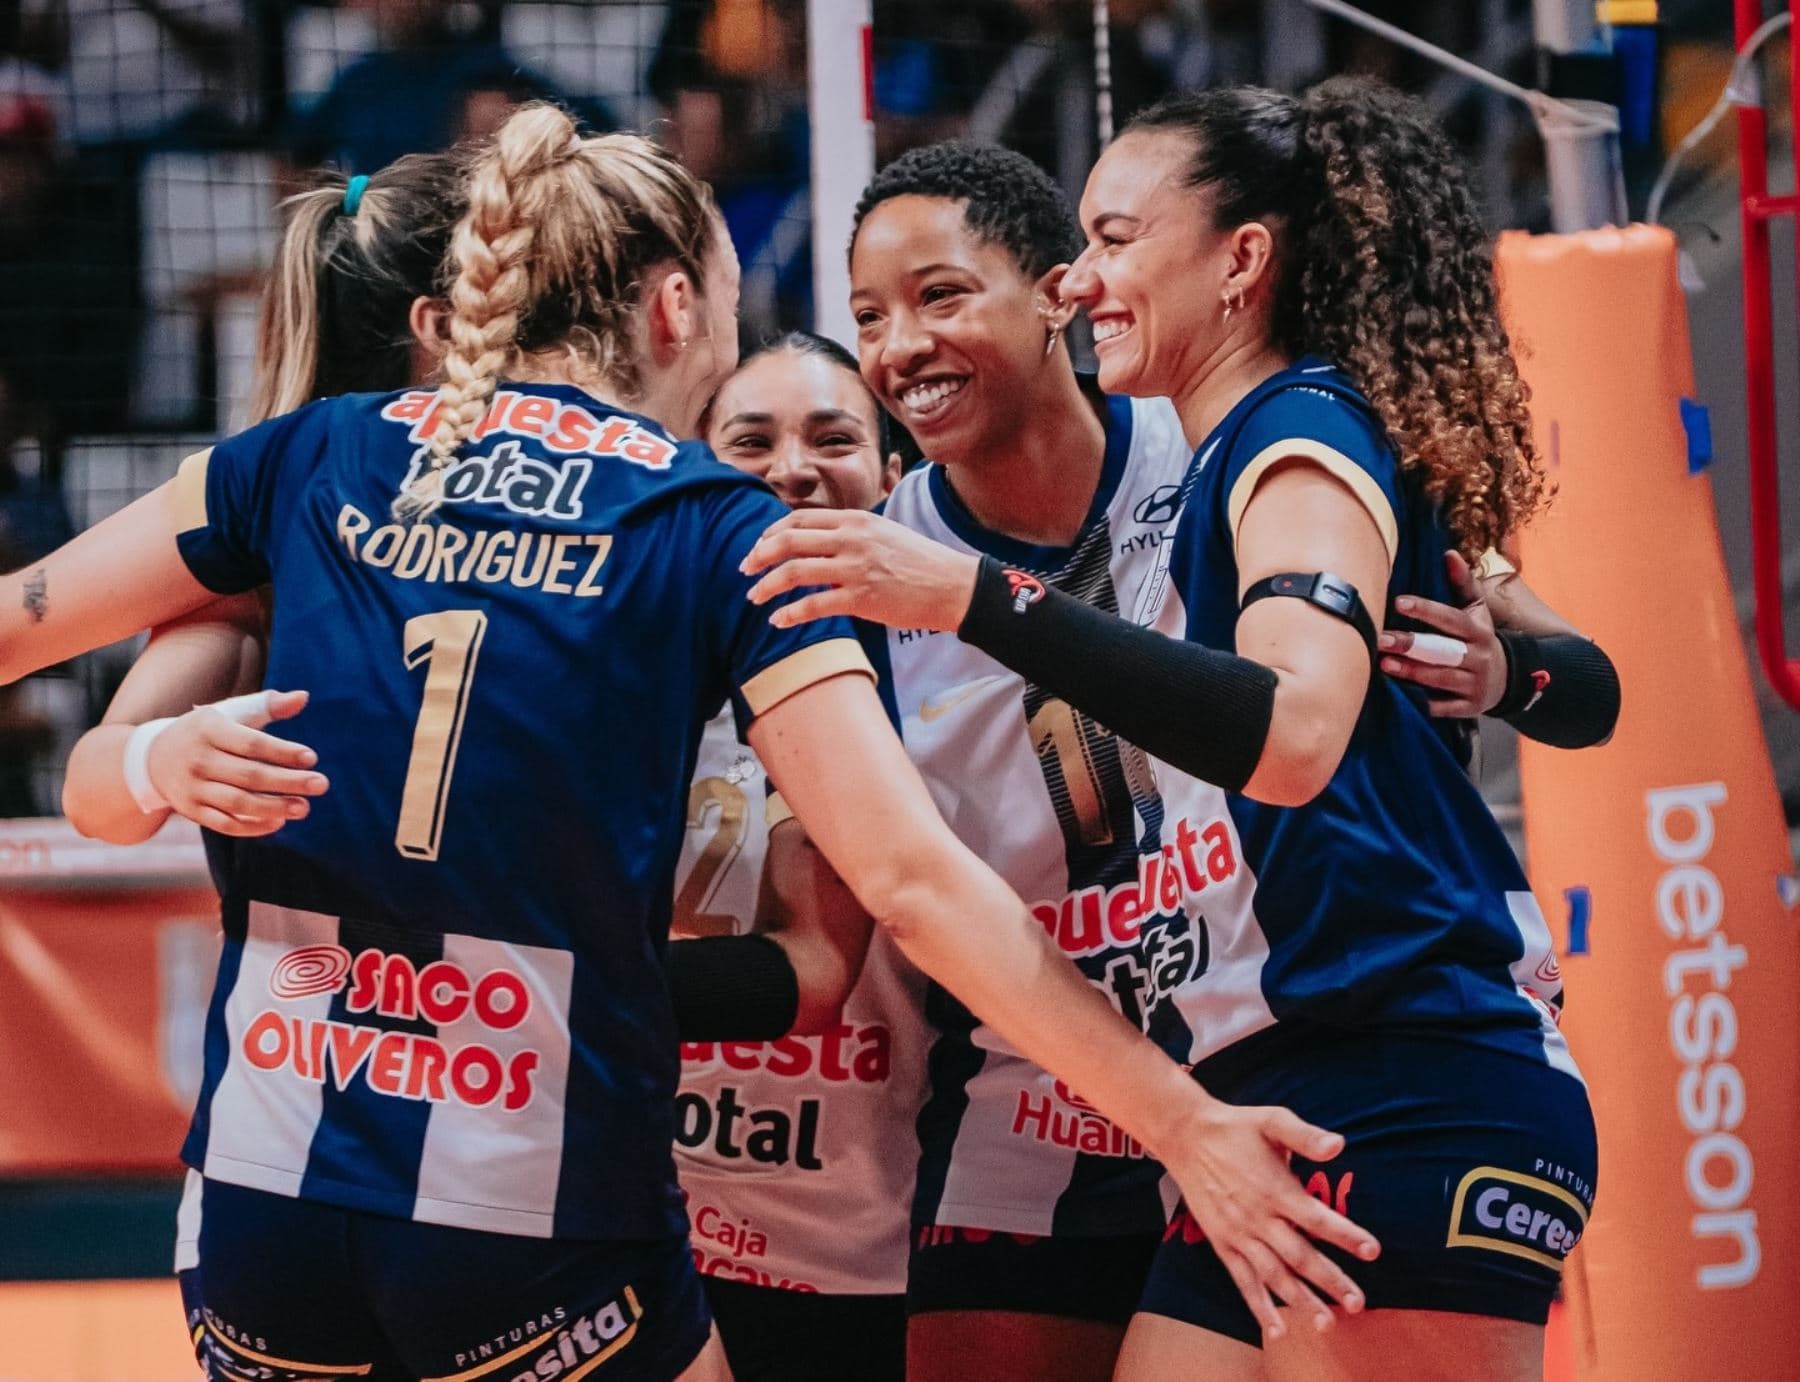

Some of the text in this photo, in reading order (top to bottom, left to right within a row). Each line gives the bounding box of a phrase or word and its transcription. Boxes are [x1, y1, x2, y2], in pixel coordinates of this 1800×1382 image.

[336, 503, 614, 598] RODRIGUEZ
[395, 609, 489, 862] 1
[346, 949, 532, 1031] SACO
[242, 1010, 540, 1112] OLIVEROS
[1645, 781, 1761, 1290] betsson
[695, 1205, 769, 1258] Caja
[1474, 1186, 1582, 1255] Ceres
[454, 1305, 567, 1368] PINTURAS
